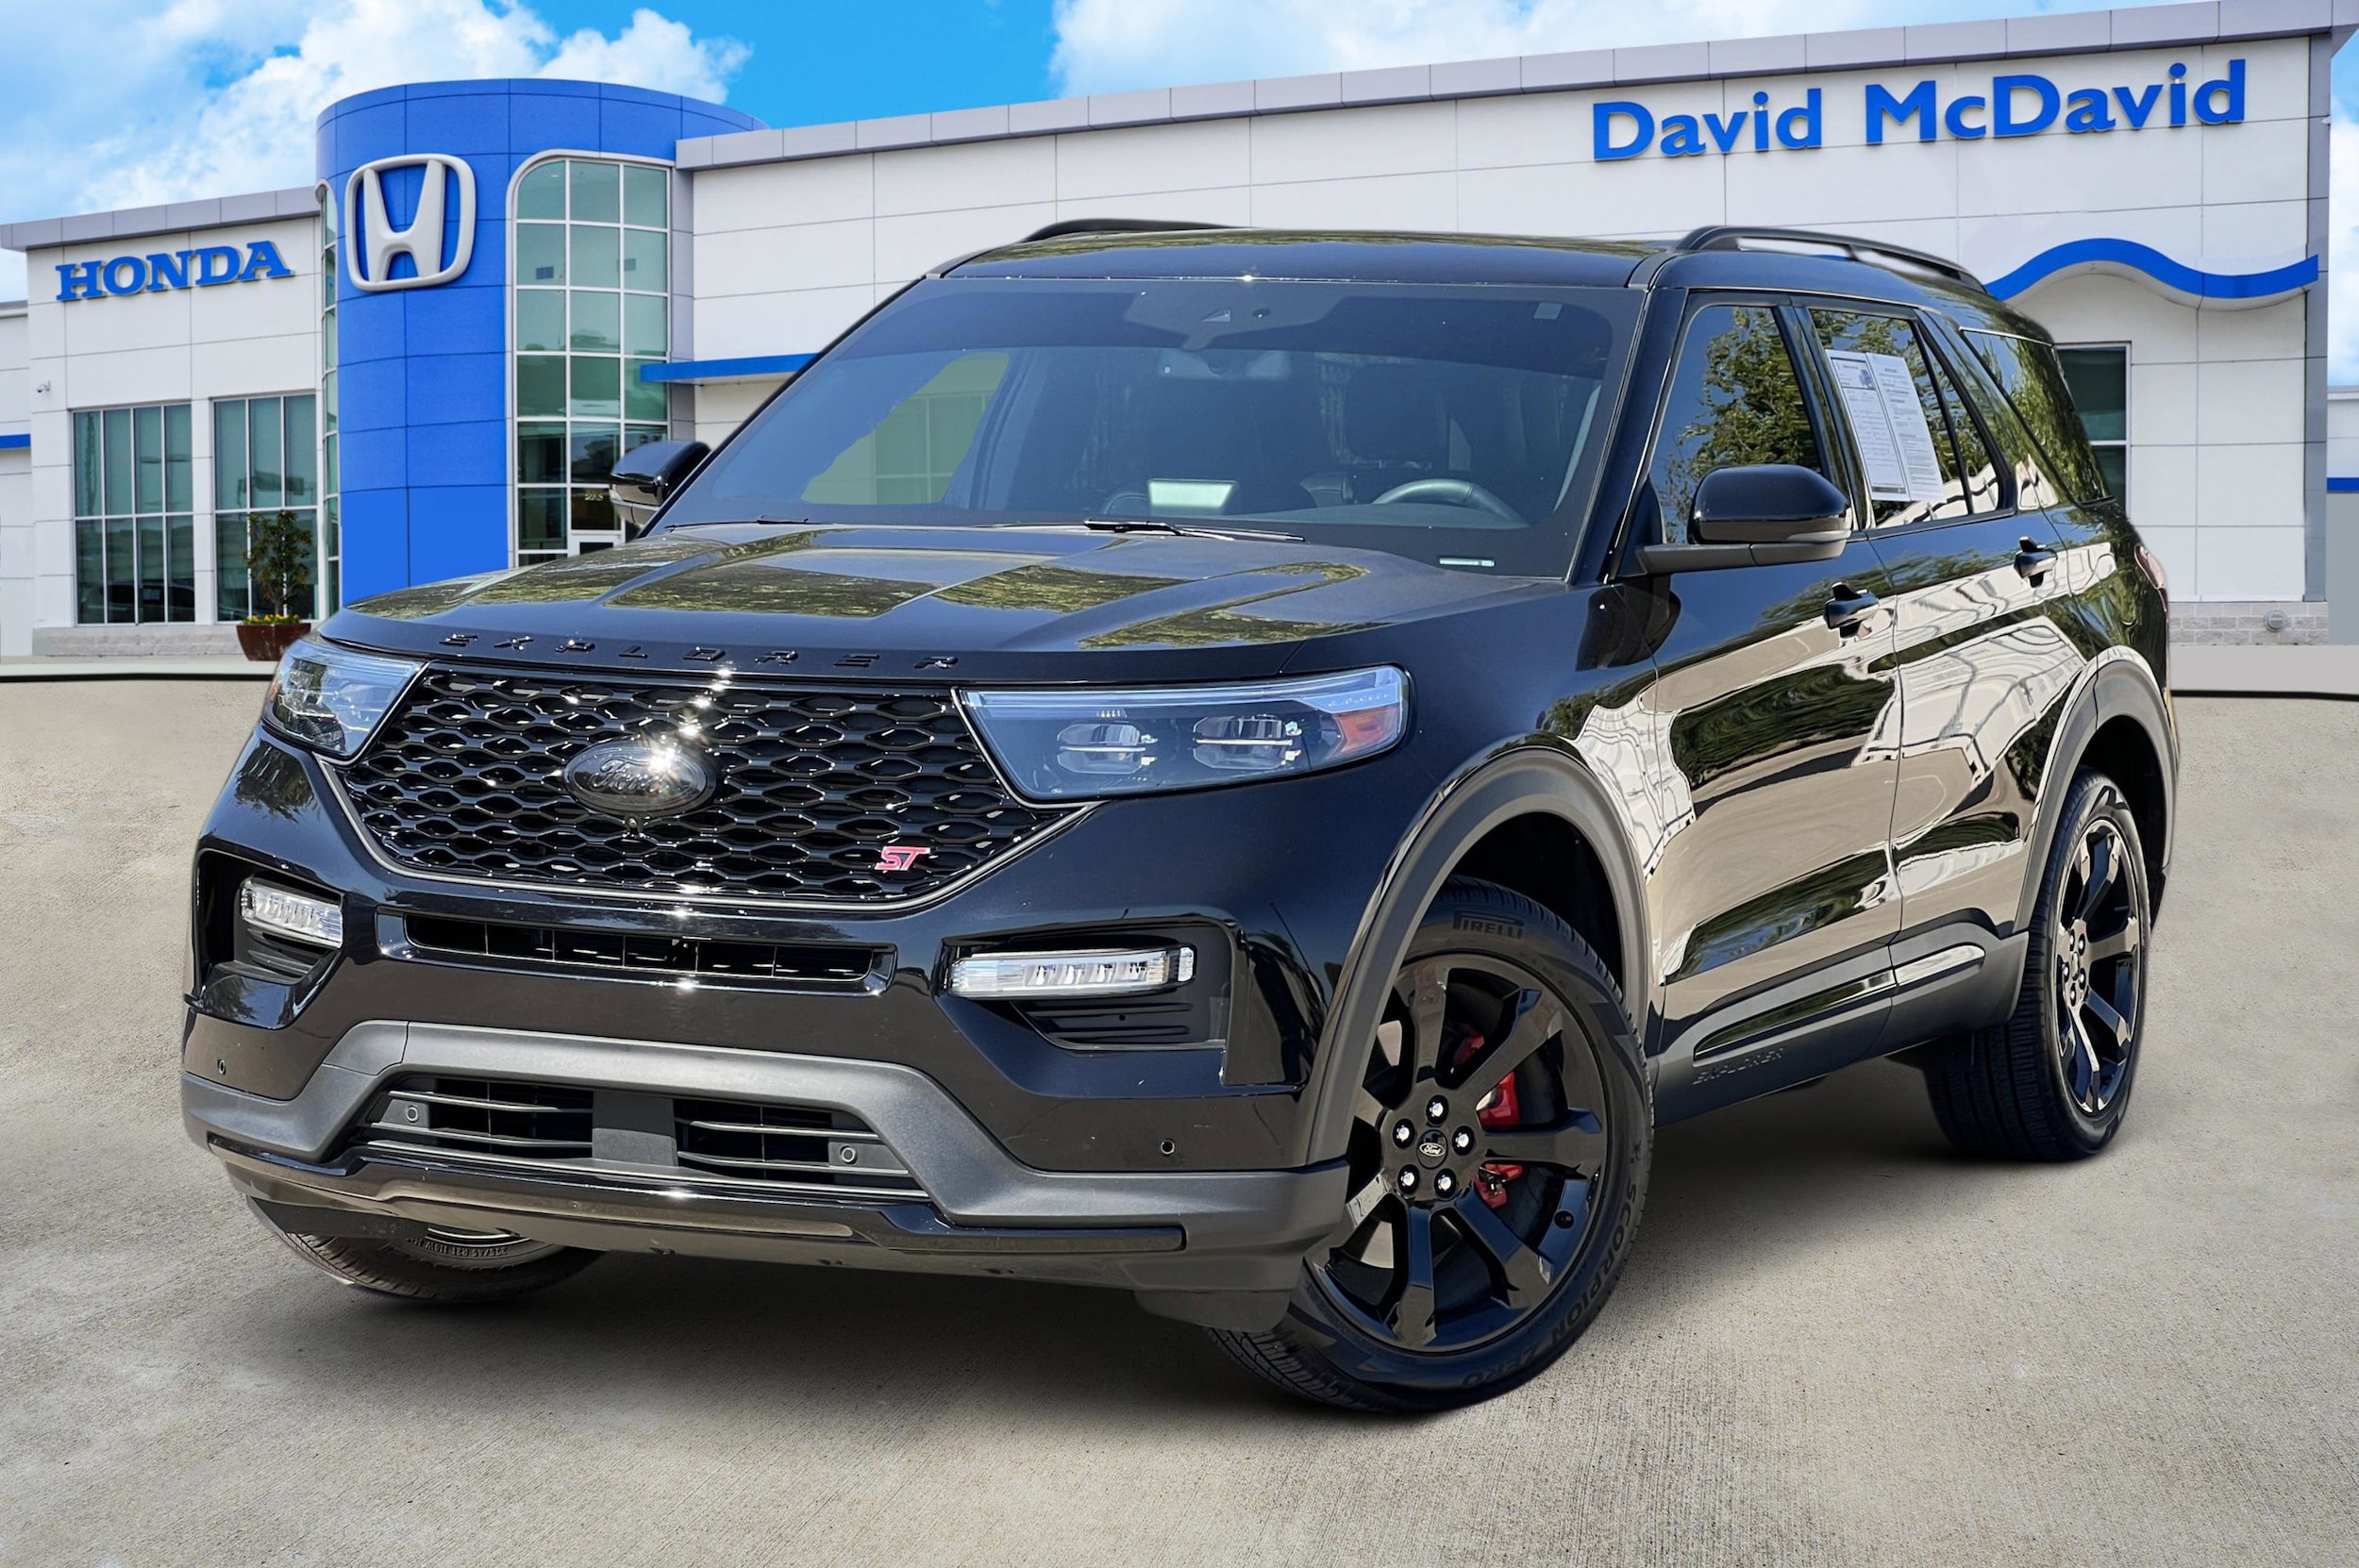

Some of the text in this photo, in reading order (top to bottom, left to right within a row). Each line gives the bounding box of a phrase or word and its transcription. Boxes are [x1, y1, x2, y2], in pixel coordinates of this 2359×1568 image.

[1593, 58, 2246, 161] David McDavid
[55, 240, 293, 302] HONDA
[438, 634, 959, 670] EXPLORER
[874, 845, 931, 871] ST
[1452, 909, 1525, 940] PIRELLI
[1550, 1176, 1638, 1346] SCORPION
